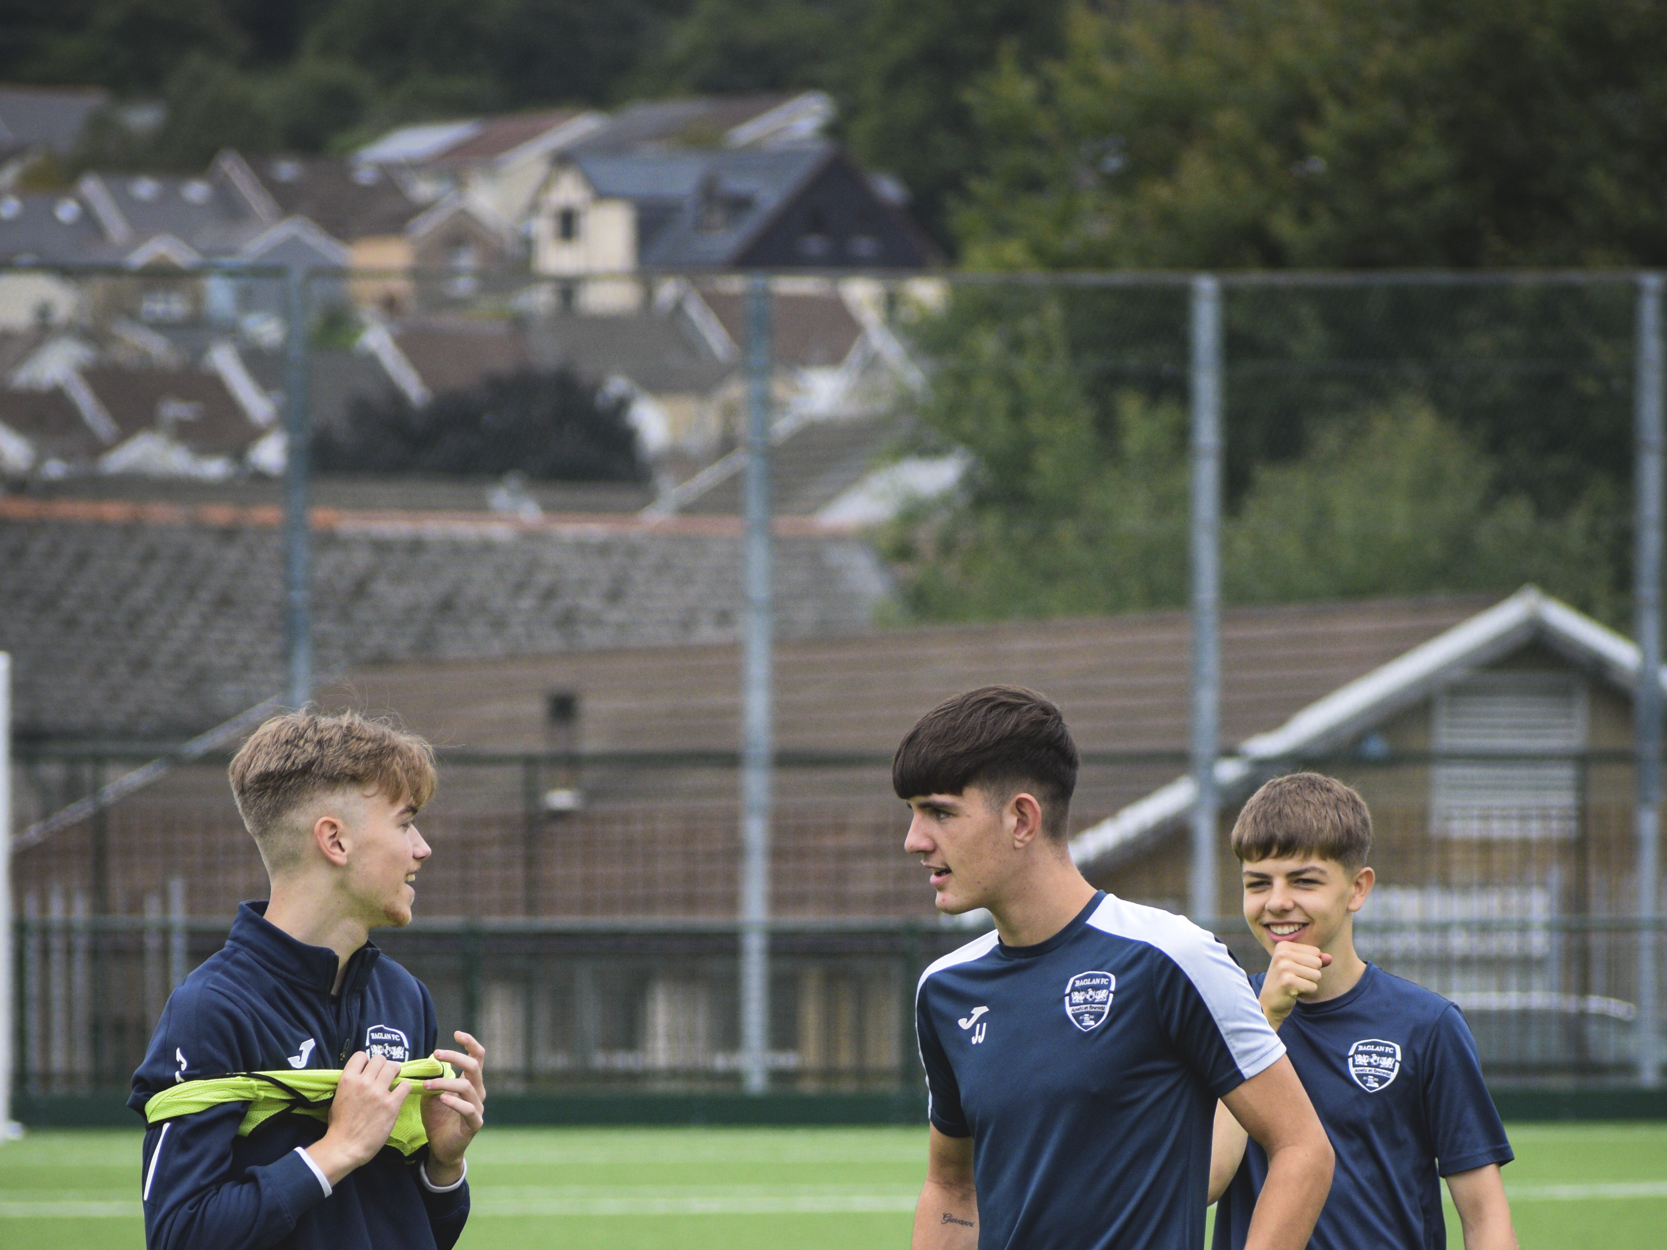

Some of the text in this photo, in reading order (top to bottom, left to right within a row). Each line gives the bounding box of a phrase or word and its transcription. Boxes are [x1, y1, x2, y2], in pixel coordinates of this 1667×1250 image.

[1075, 977, 1110, 987] BAGLAN FC
[370, 1032, 391, 1040] BAGLAN
[1358, 1044, 1395, 1054] BAGLAN FC
